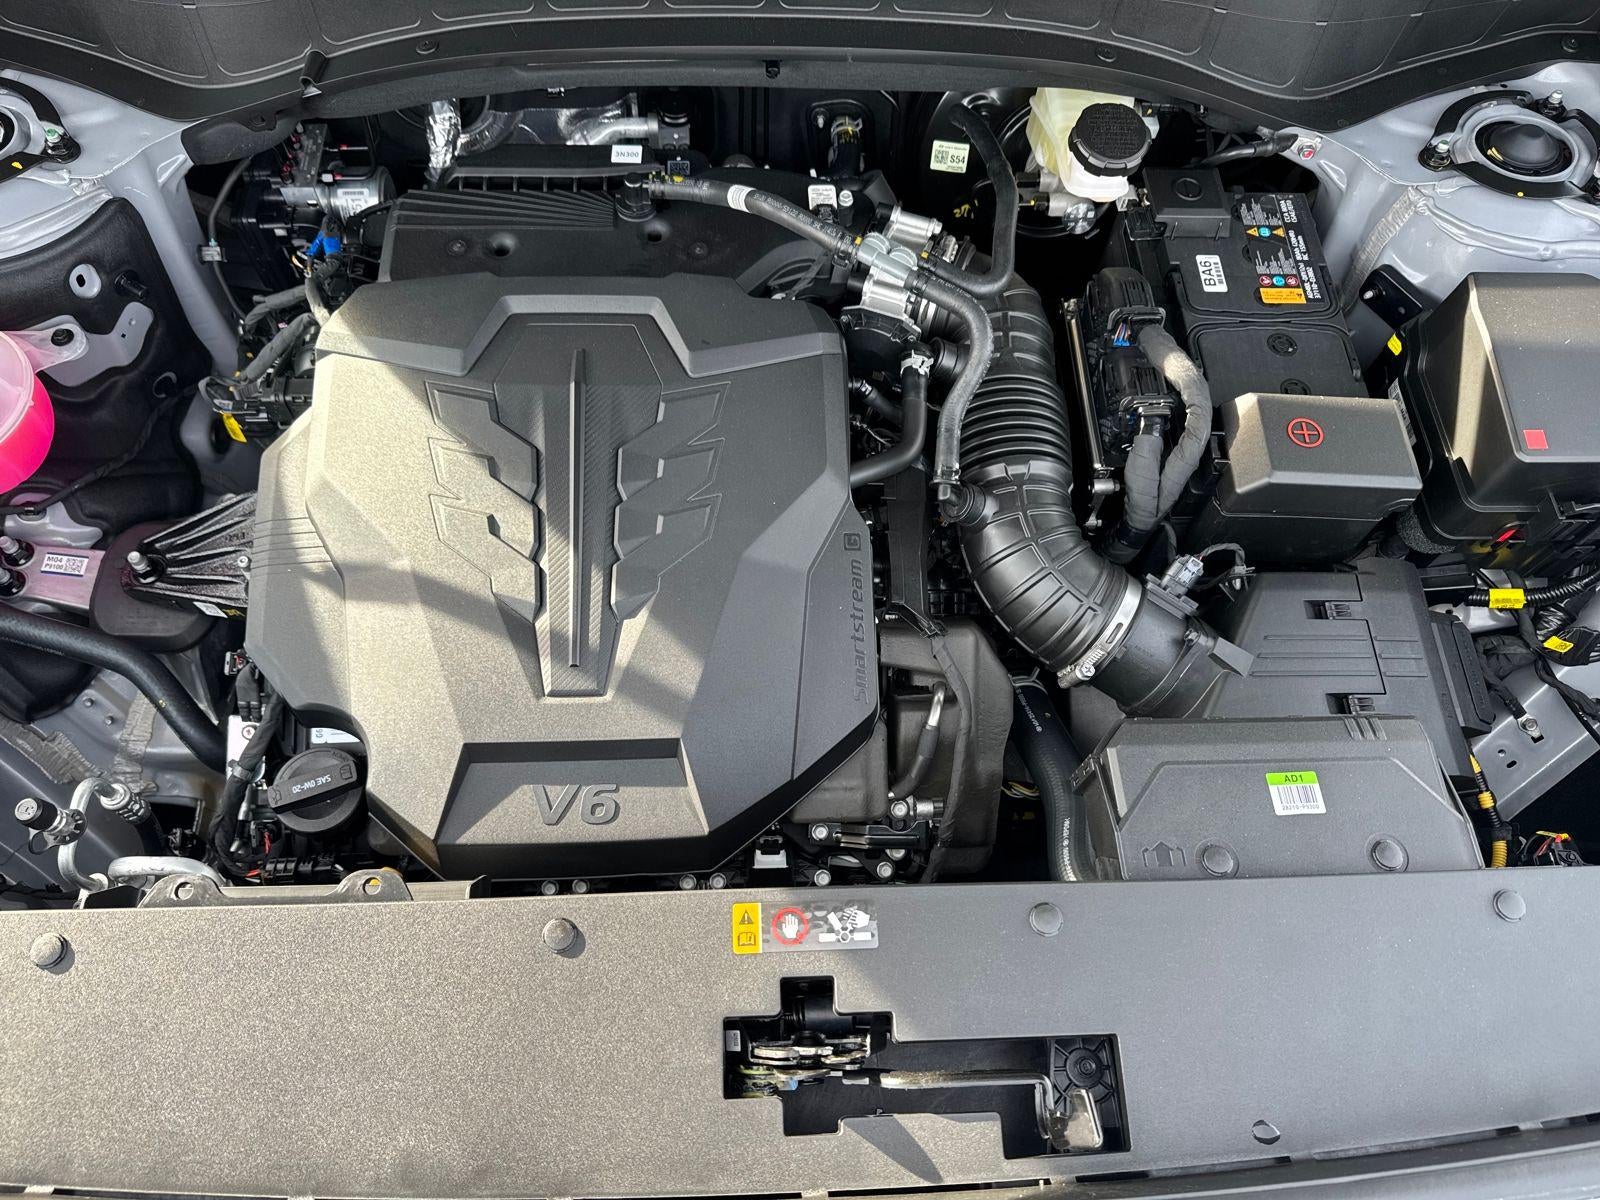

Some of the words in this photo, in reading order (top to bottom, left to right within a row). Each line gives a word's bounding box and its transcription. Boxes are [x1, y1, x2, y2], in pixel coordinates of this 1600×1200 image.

[949, 154, 966, 165] S54
[1283, 213, 1291, 223] CCA
[1301, 253, 1309, 261] RC
[1199, 261, 1217, 286] BA6
[850, 558, 869, 705] Smartstream
[316, 774, 331, 786] SAE
[1284, 774, 1304, 783] AD1
[292, 780, 316, 793] 0W-20
[532, 783, 621, 826] V6
